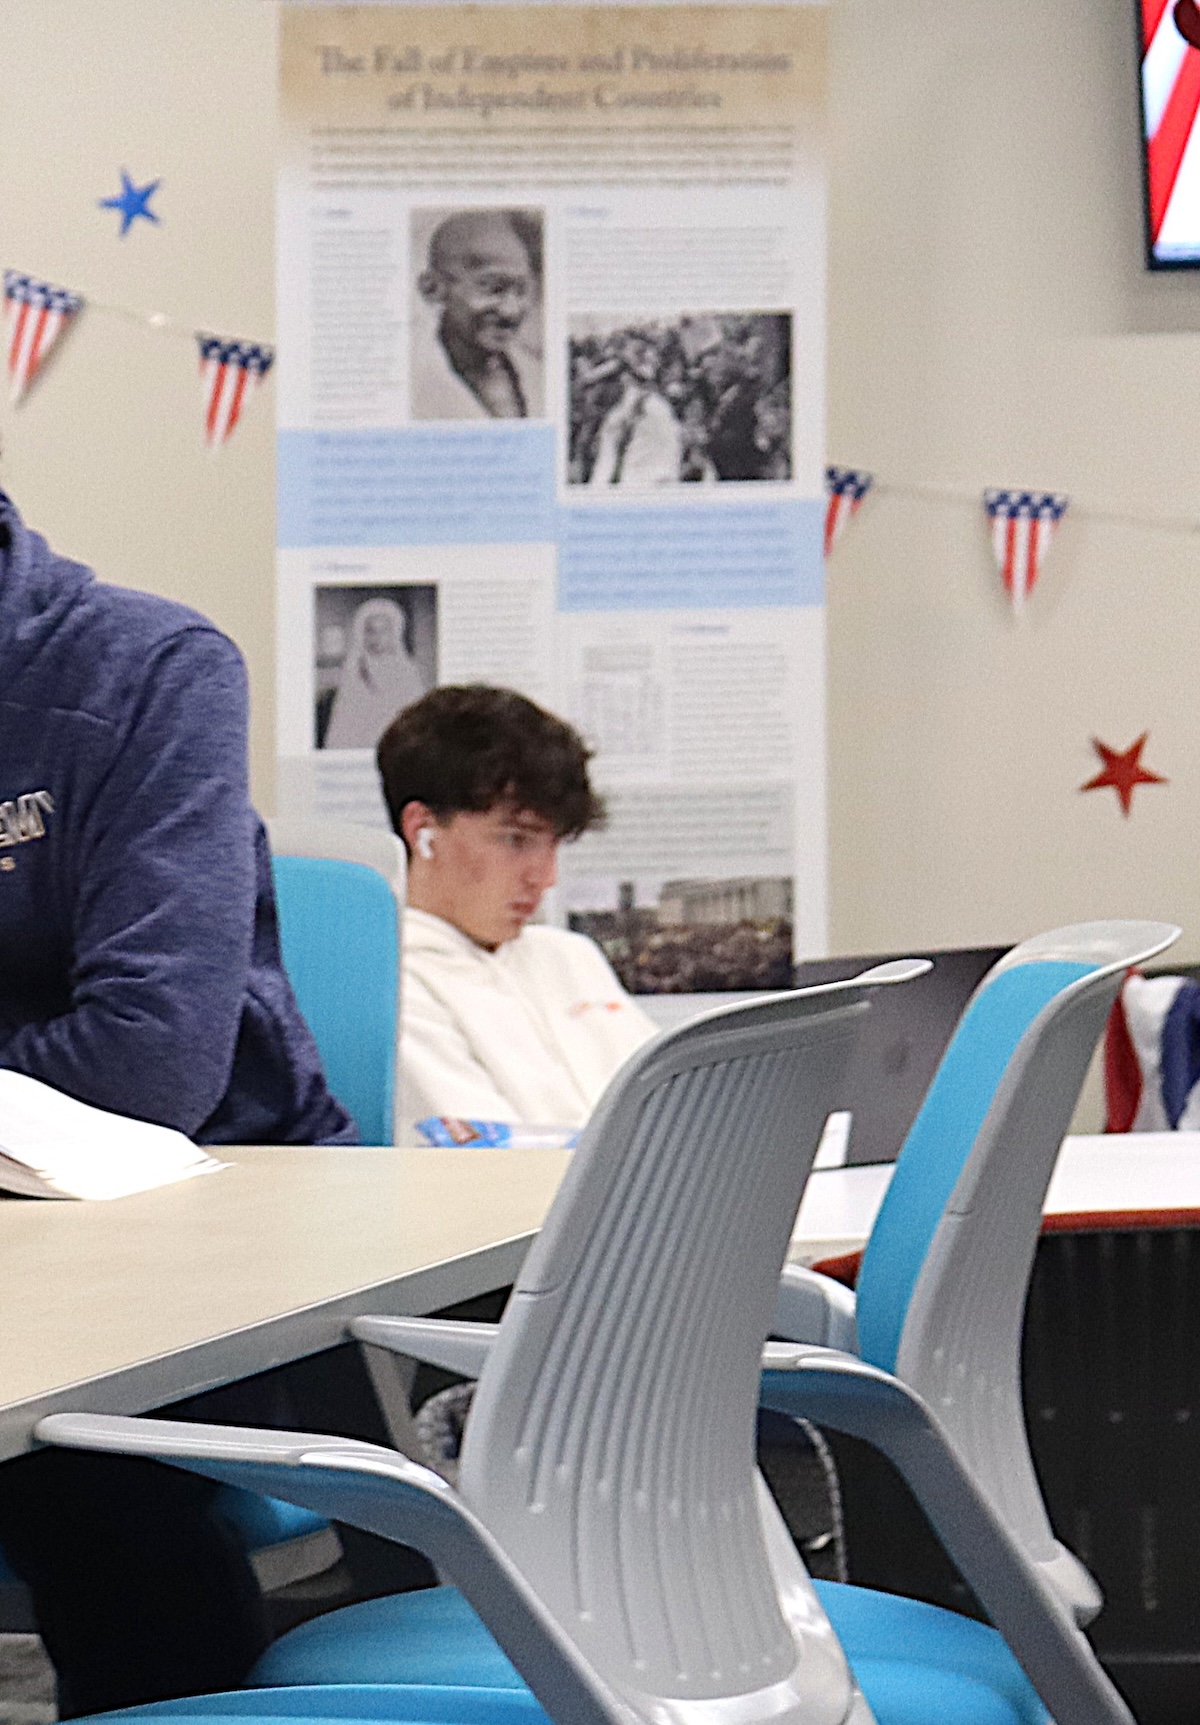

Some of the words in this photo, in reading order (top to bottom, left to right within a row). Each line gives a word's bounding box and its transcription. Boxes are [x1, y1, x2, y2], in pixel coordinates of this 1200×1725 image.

[316, 46, 367, 77] The
[372, 47, 422, 76] Fall
[427, 47, 456, 76] of
[460, 46, 569, 80] Empires
[577, 48, 624, 75] and
[386, 82, 420, 110] of
[421, 82, 586, 118] Independent
[593, 83, 722, 111] Countries
